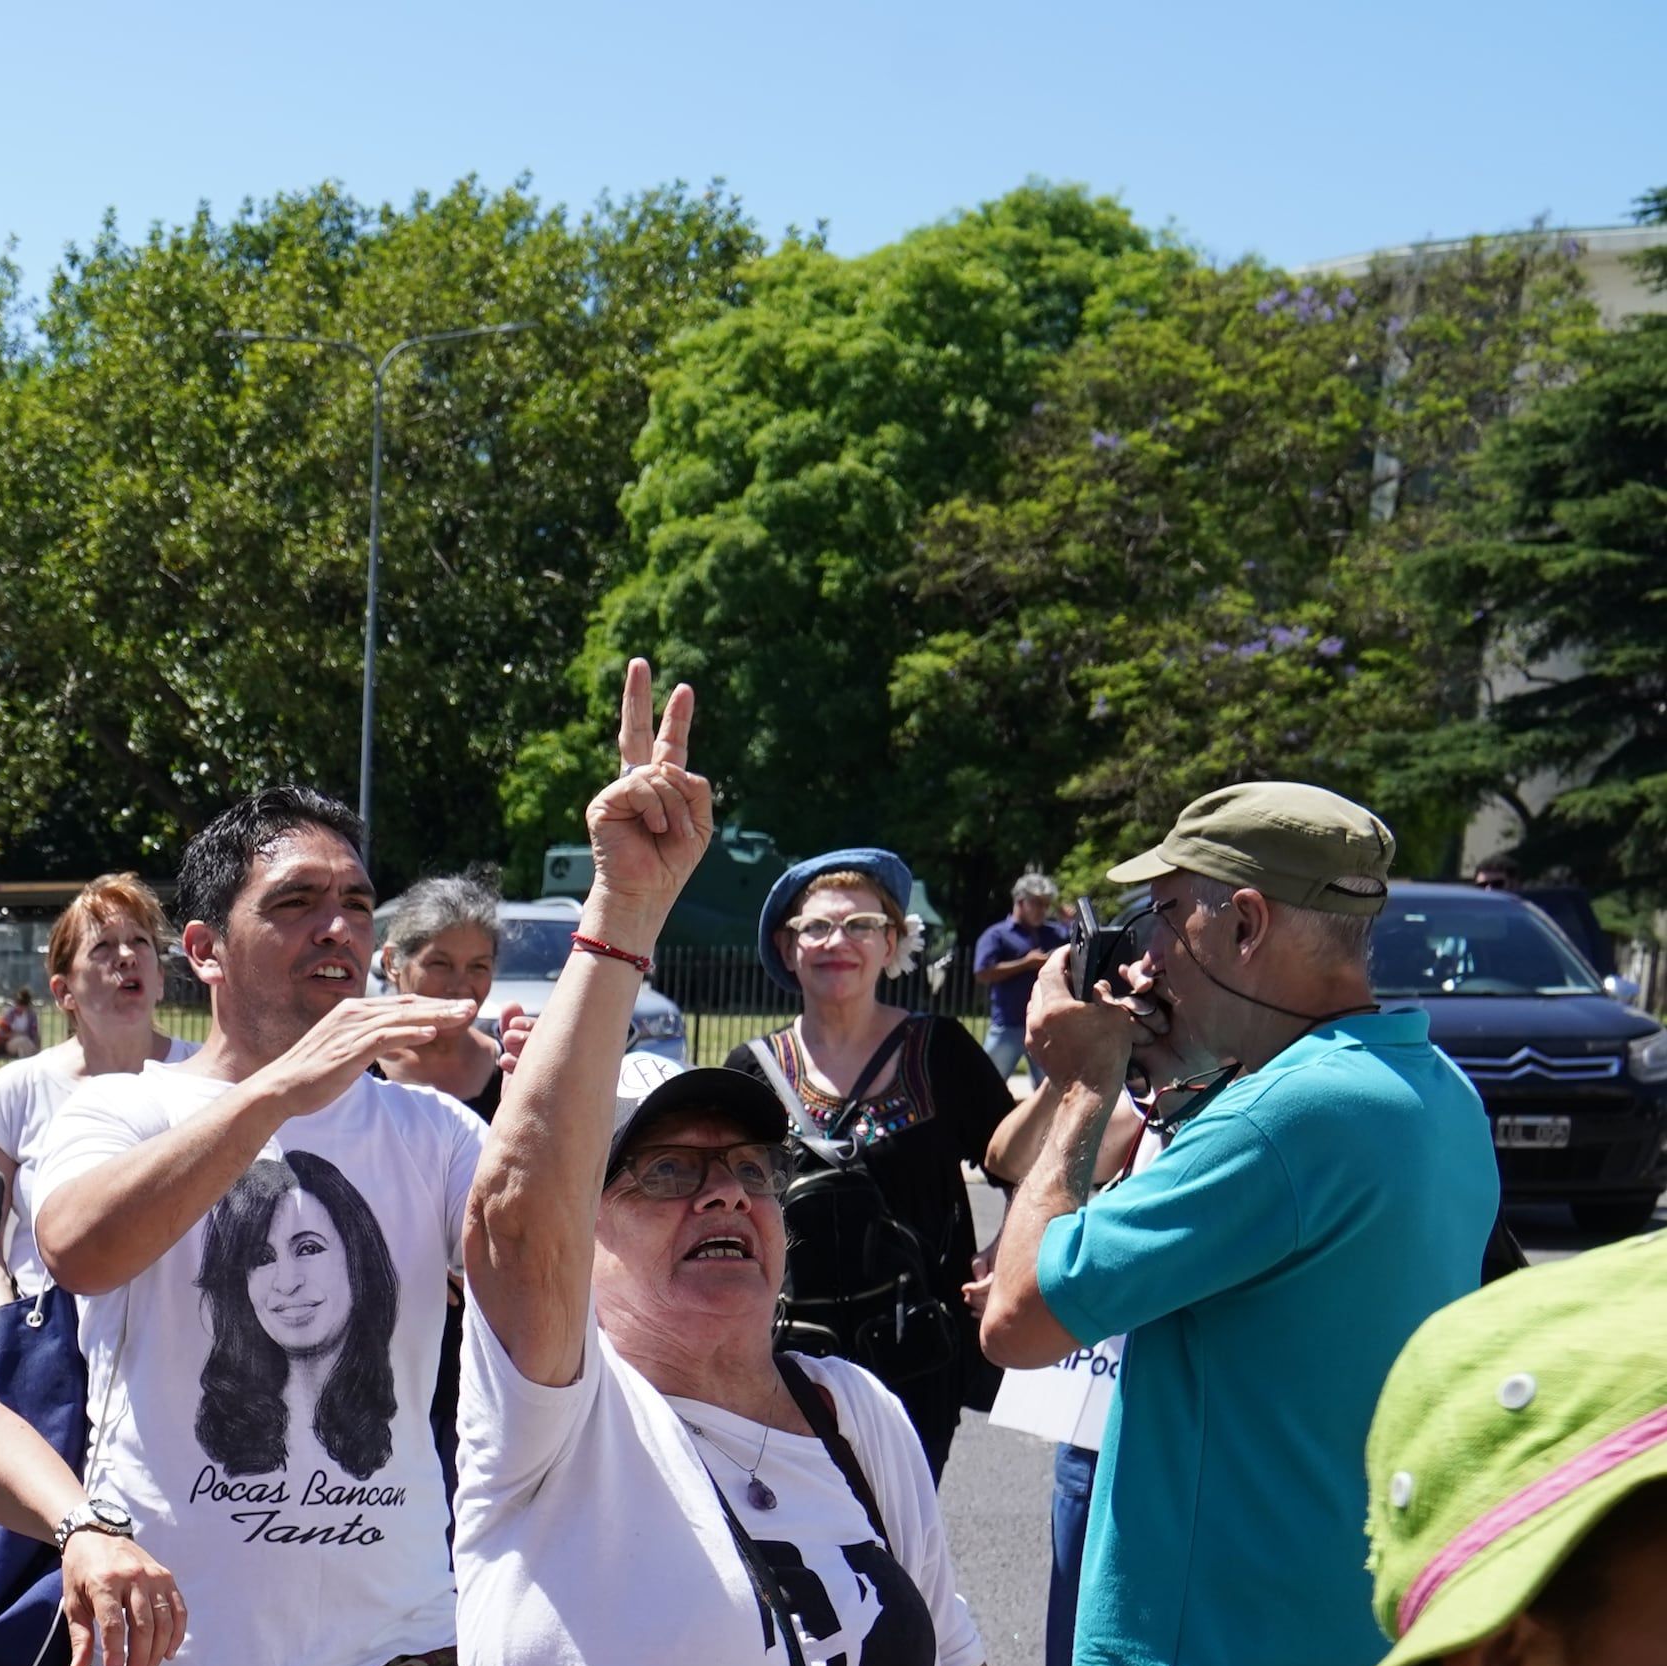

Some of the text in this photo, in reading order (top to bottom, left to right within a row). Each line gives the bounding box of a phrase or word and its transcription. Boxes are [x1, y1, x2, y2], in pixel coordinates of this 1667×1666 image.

[189, 1465, 406, 1507] Pocas Bancan
[230, 1510, 385, 1545] Tanto
